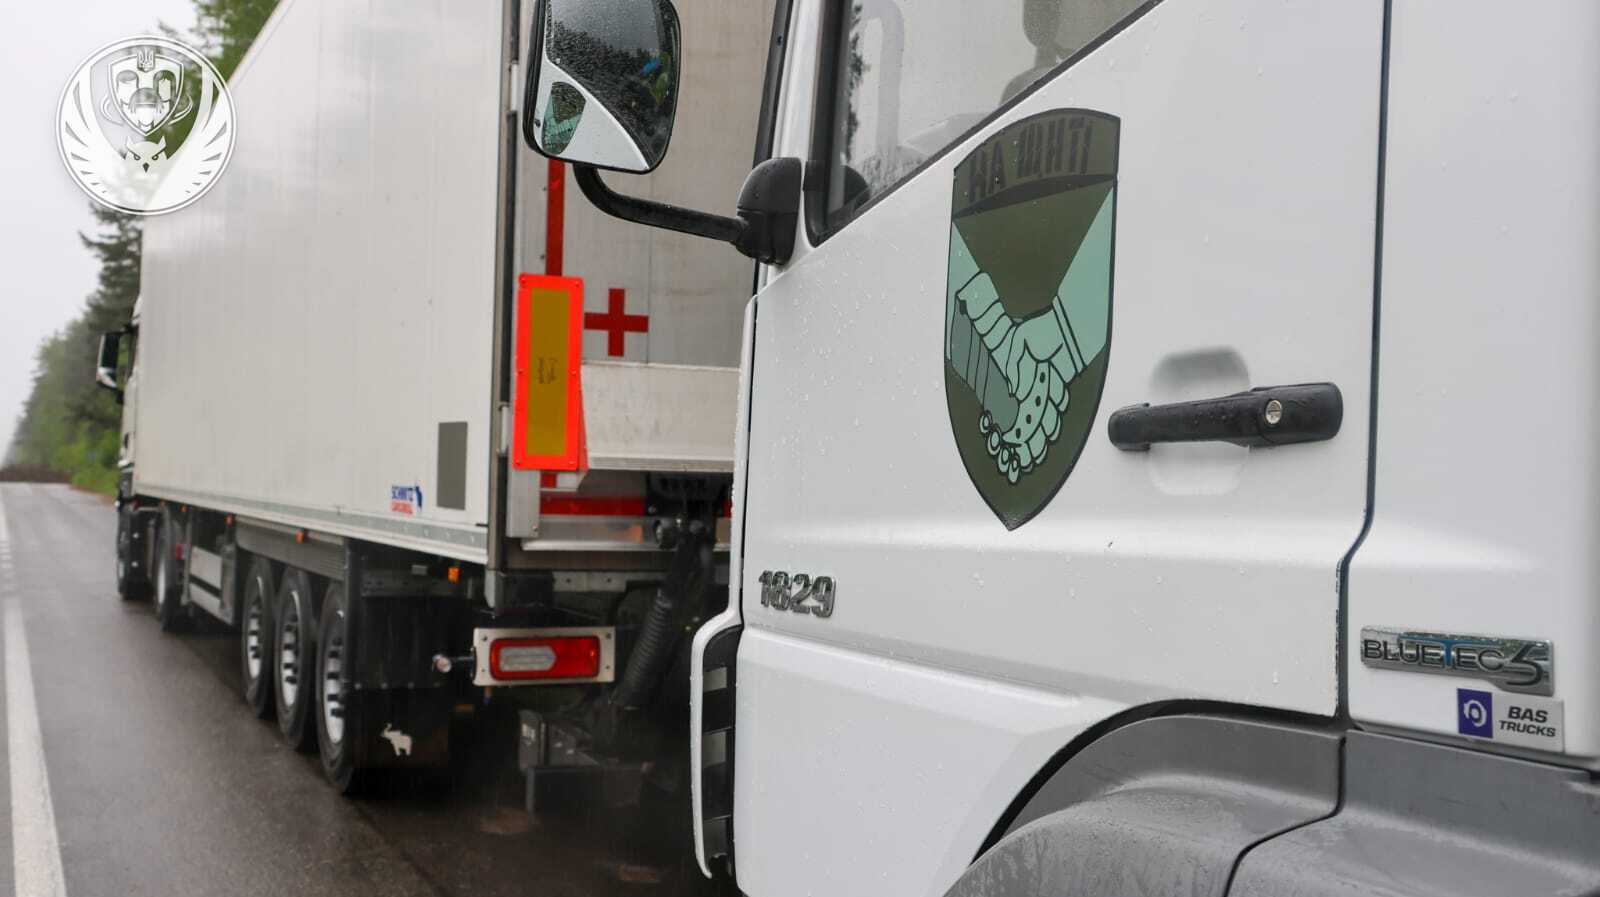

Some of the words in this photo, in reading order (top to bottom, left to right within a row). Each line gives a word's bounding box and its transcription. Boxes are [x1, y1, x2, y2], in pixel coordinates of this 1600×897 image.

[759, 570, 836, 618] 1829
[1508, 705, 1549, 723] BAS
[1499, 720, 1557, 738] TRUCKS
